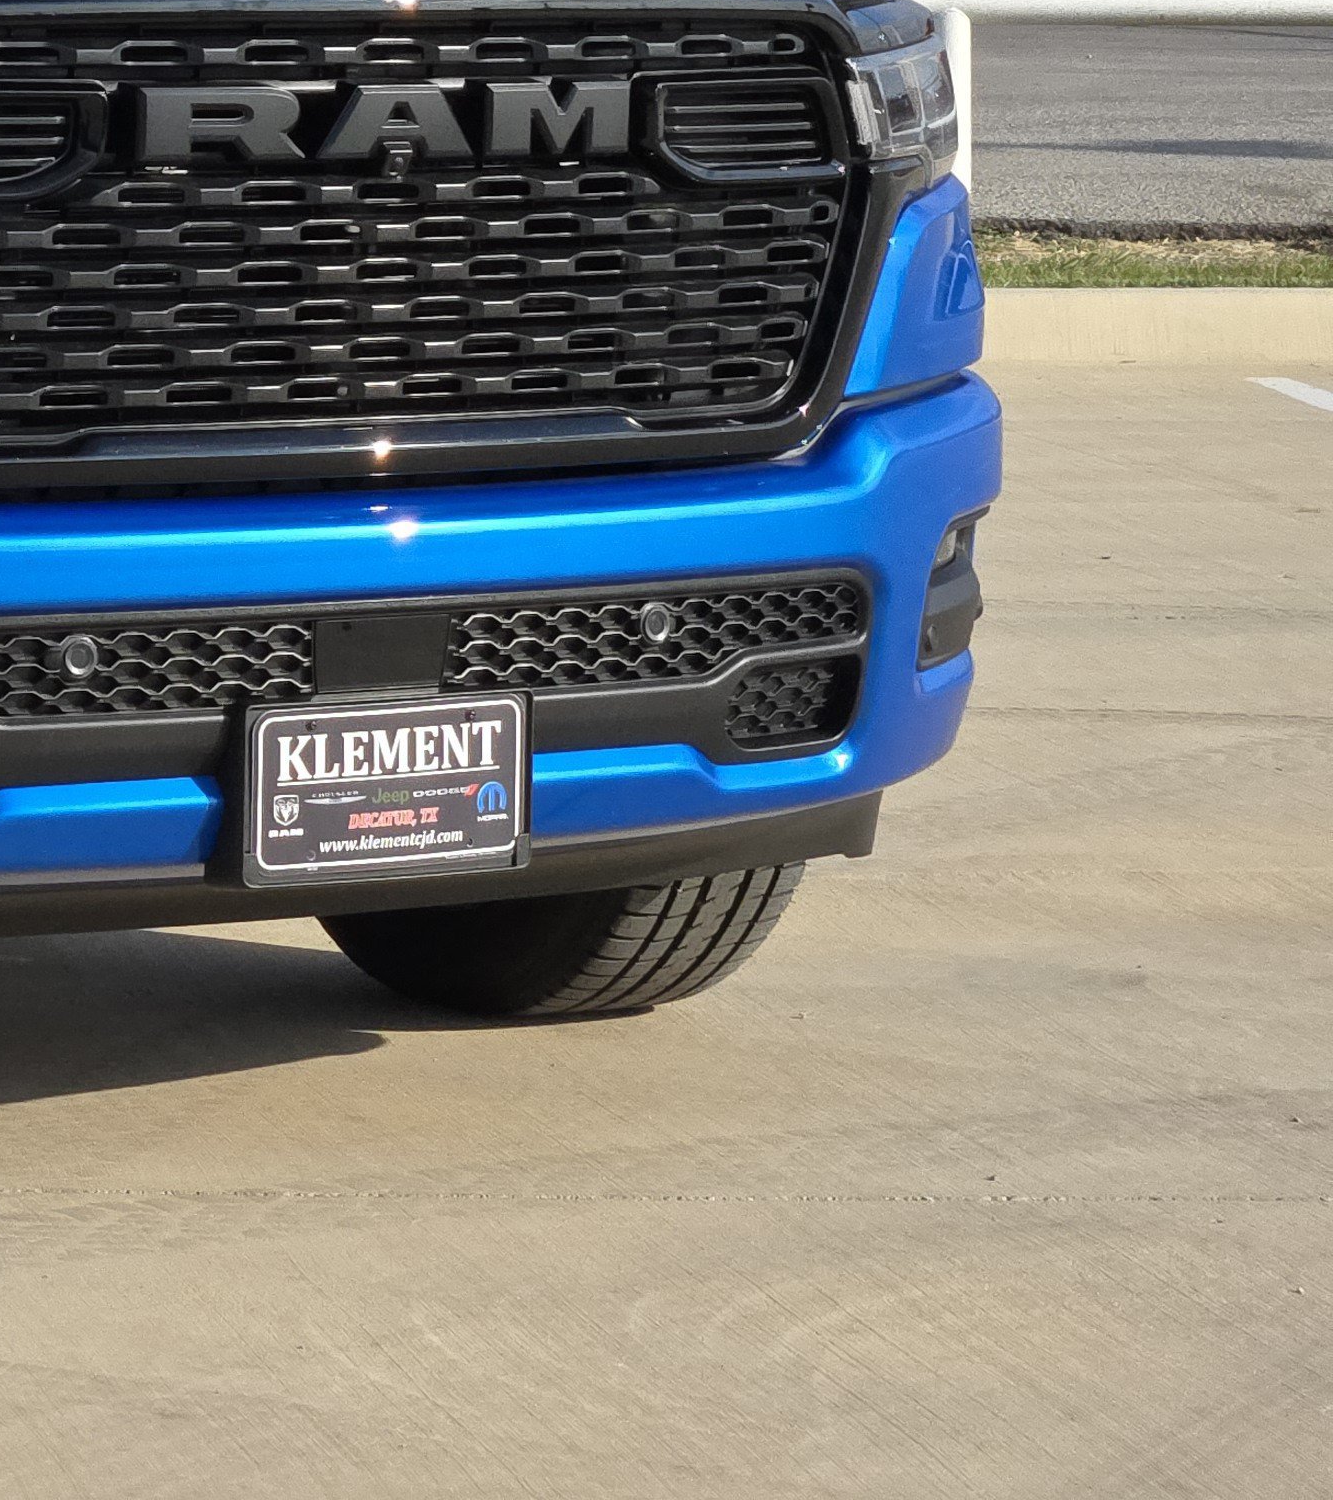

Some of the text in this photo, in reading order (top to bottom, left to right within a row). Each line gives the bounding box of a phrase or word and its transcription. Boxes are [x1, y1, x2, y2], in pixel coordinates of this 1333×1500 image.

[137, 80, 631, 159] RAM
[277, 720, 502, 782] KLEMENT
[371, 787, 410, 805] Jeep
[420, 807, 440, 823] TX
[319, 828, 463, 853] www.klementcjd.com
